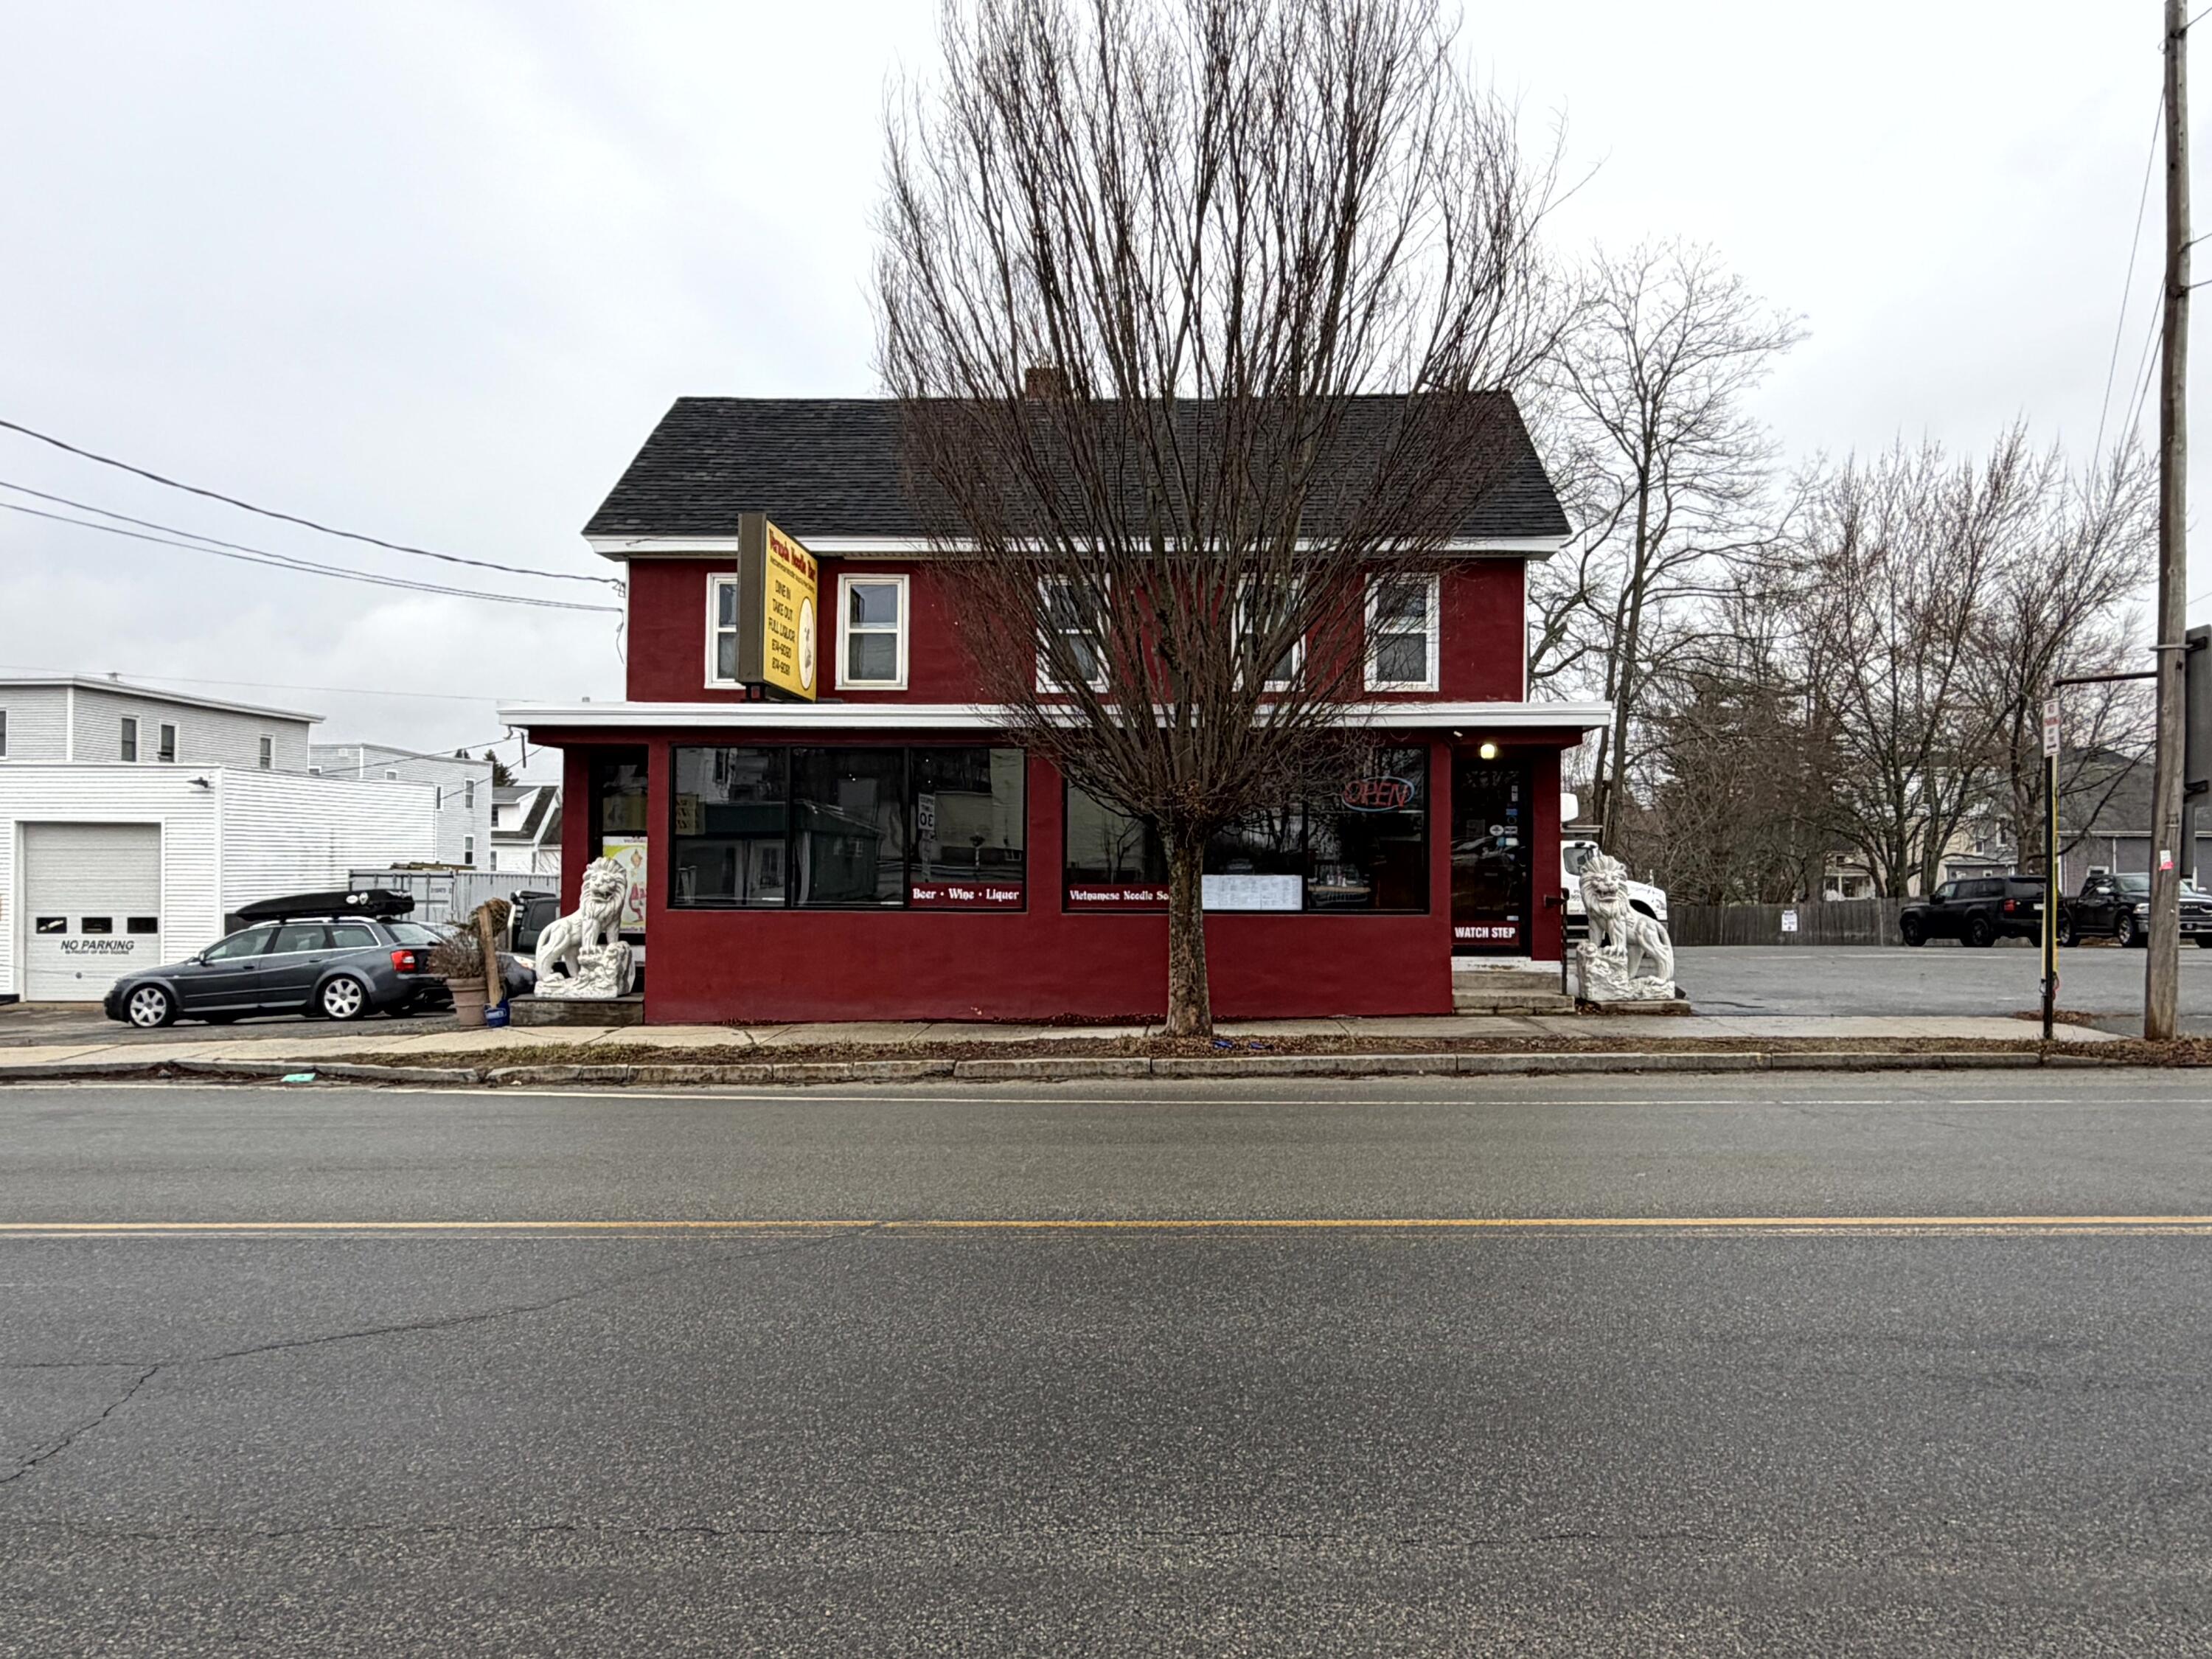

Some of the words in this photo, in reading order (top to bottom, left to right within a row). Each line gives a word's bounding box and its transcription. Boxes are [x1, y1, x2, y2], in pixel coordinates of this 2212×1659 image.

[775, 580, 786, 597] DINE
[772, 598, 784, 616] TAKE
[785, 605, 793, 622] OUT
[768, 616, 779, 634] FULL
[780, 623, 795, 643] LIQUOR
[1344, 779, 1408, 807] OPEN
[912, 888, 936, 899] Beer
[948, 888, 974, 900] Wine
[986, 888, 1019, 902] Liquor
[1070, 890, 1120, 901] Vietnamese
[1123, 890, 1153, 900] Noodle
[1156, 890, 1169, 900] So
[1454, 927, 1489, 938] WATCH
[1491, 927, 1515, 938] STEP
[60, 940, 79, 950] NO
[81, 940, 134, 950] PARKING
